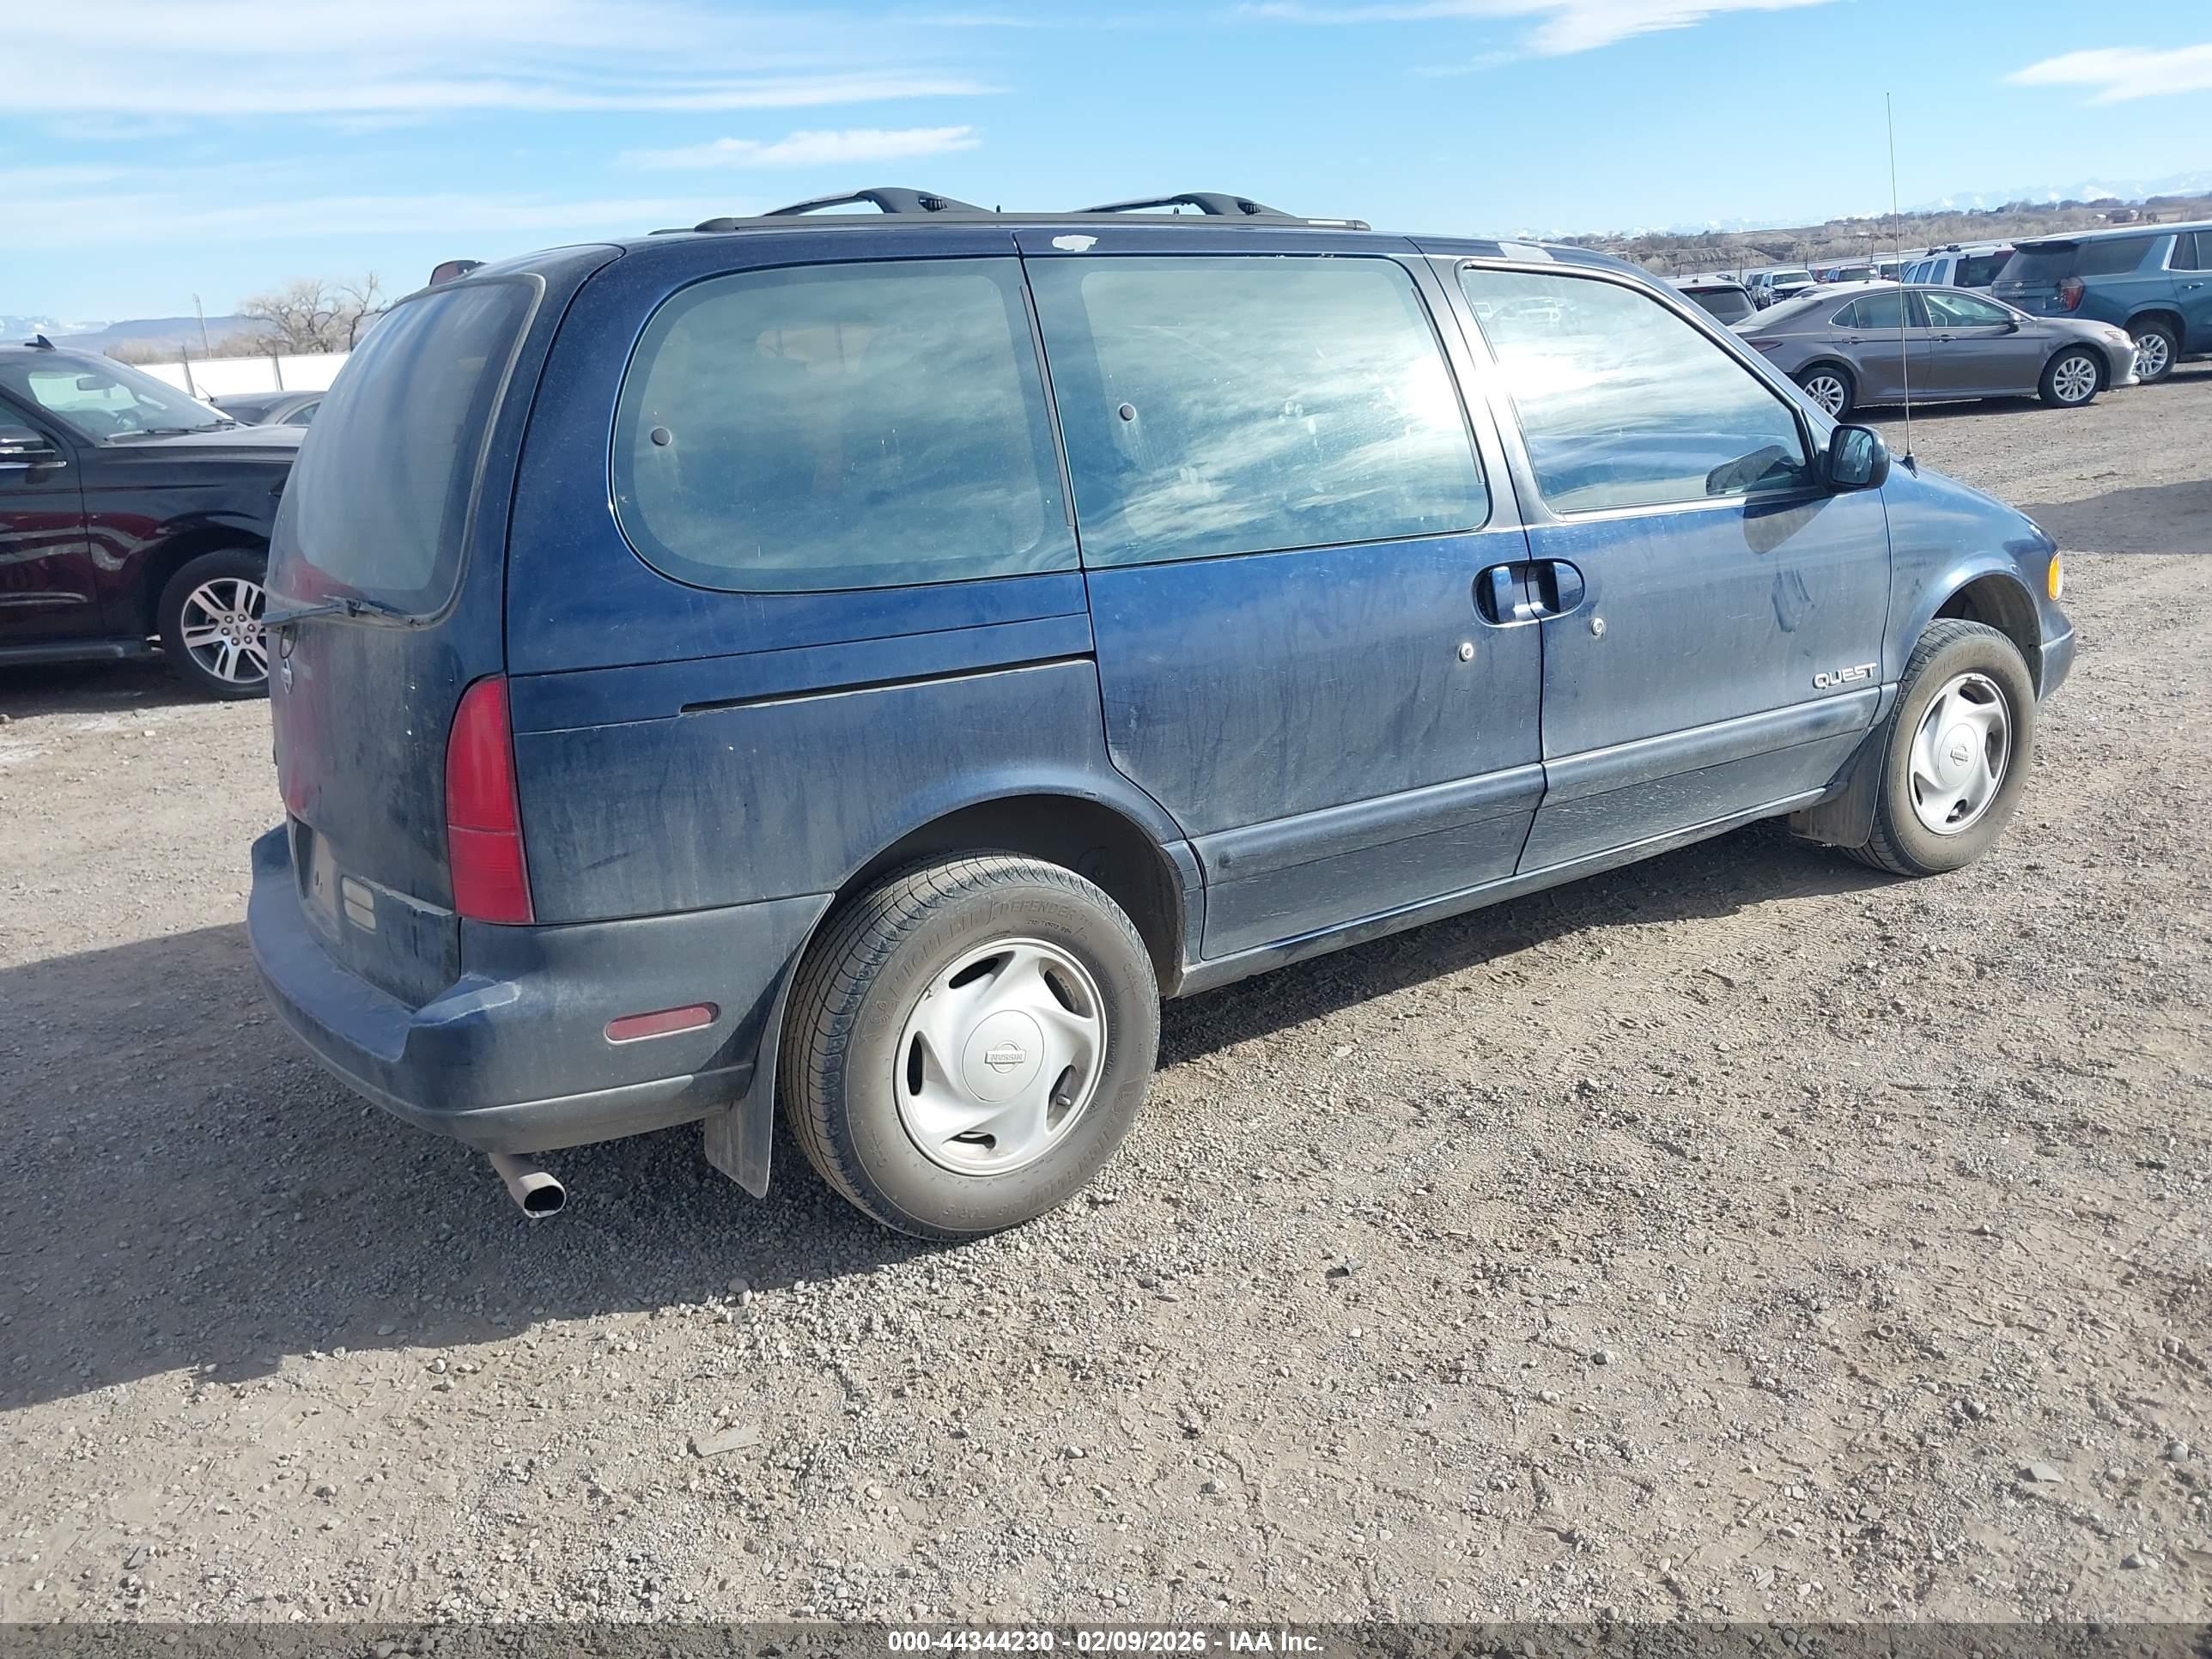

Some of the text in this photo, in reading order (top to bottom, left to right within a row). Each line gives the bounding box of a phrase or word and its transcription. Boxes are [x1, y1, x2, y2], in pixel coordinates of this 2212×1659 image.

[1813, 662, 1877, 690] QUEST
[1000, 899, 1077, 921] DEFENDER
[990, 1053, 1024, 1061] NISSAN
